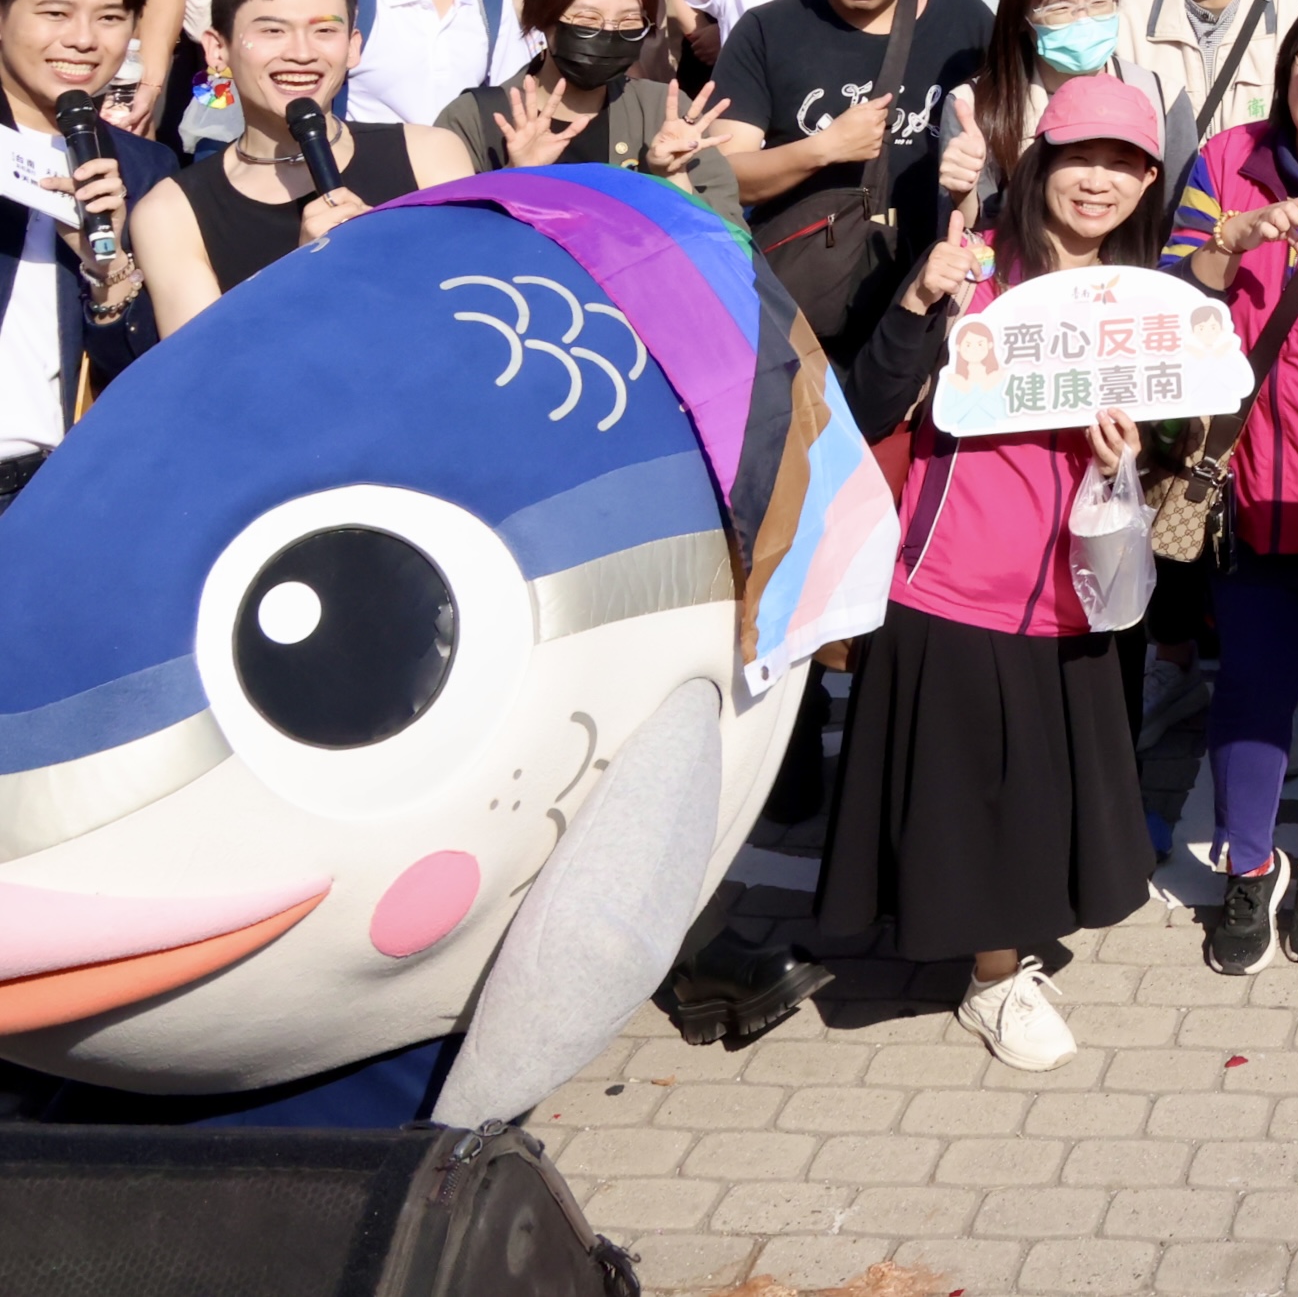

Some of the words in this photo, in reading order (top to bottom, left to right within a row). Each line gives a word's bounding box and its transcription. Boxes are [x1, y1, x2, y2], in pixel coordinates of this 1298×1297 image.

[1247, 98, 1265, 118] 衛
[1003, 313, 1182, 365] 齊心反毒
[1004, 361, 1183, 414] 健康臺南
